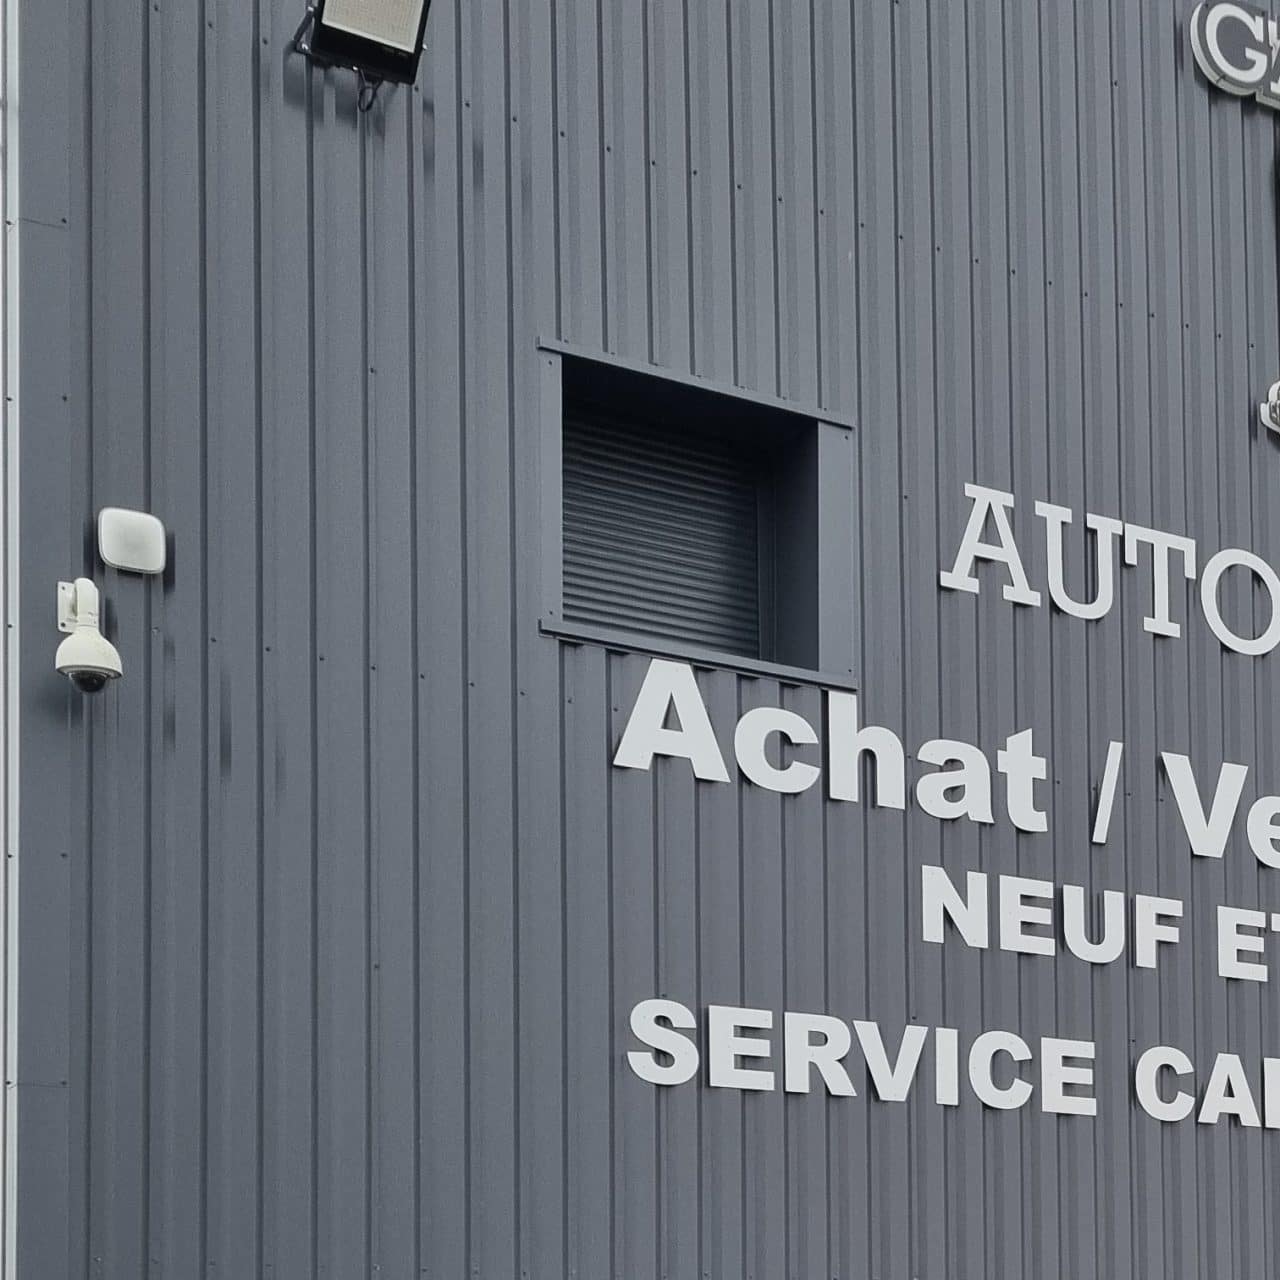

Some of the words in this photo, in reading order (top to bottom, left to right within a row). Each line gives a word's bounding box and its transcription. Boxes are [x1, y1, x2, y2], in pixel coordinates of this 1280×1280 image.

[613, 658, 1048, 832] Achat
[1092, 741, 1124, 844] /
[922, 865, 1183, 969] NEUF
[627, 999, 1096, 1116] SERVICE
